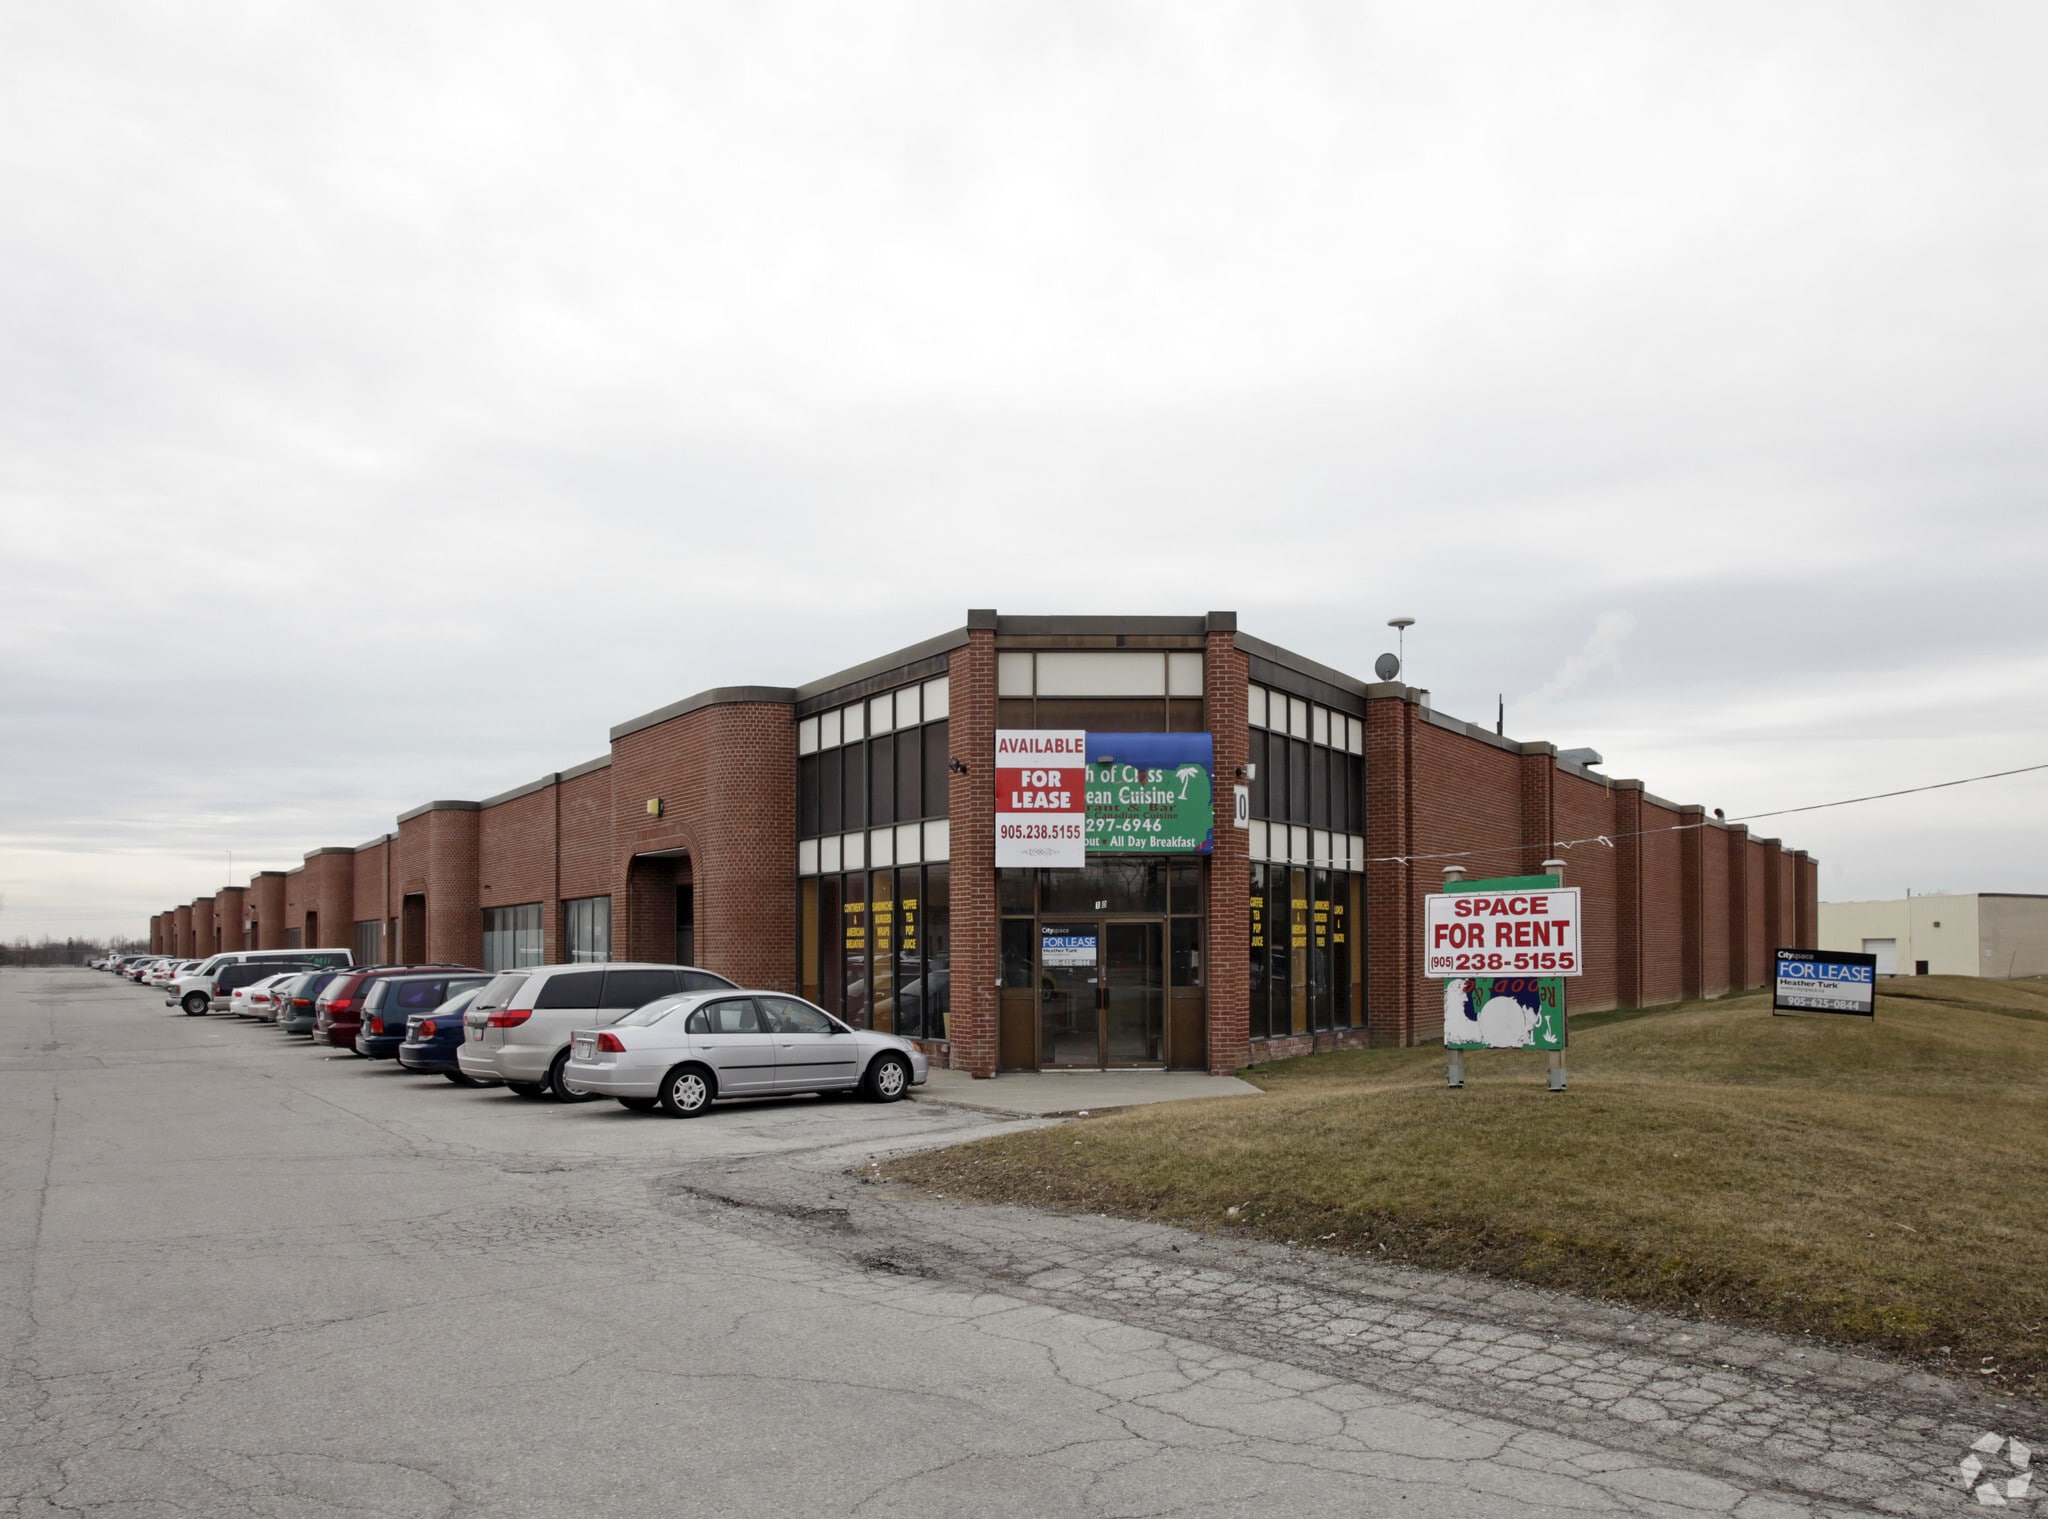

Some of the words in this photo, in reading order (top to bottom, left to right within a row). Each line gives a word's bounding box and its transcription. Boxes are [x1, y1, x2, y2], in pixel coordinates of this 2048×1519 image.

[998, 738, 1084, 753] AVAILABLE
[1021, 770, 1062, 787] FOR
[1100, 765, 1117, 783] of
[1122, 765, 1163, 783] Clss
[1011, 791, 1071, 809] LEASE
[1118, 786, 1174, 804] Cuisine
[1094, 811, 1139, 819] Canadian
[1143, 811, 1178, 819] Cuisine
[1149, 803, 1176, 812] Bar
[1000, 824, 1081, 839] 905.238.5155
[1110, 835, 1124, 847] All
[1128, 835, 1147, 849] Day
[1150, 835, 1196, 848] Breakfast
[1454, 896, 1549, 917] SPACE
[1042, 937, 1065, 947] FOR
[1065, 937, 1096, 947] LEASE
[1434, 923, 1485, 949] FOR
[1495, 920, 1570, 948] RENT
[1431, 956, 1454, 970] (905)
[1455, 952, 1575, 970] 238-5155
[1777, 951, 1814, 960] Cityspace
[1780, 962, 1816, 978] FOR
[1818, 964, 1871, 982] LEASE
[1780, 978, 1816, 987] Heather
[1818, 981, 1839, 989] Turk
[1787, 996, 1859, 1010] 905-625-0844
